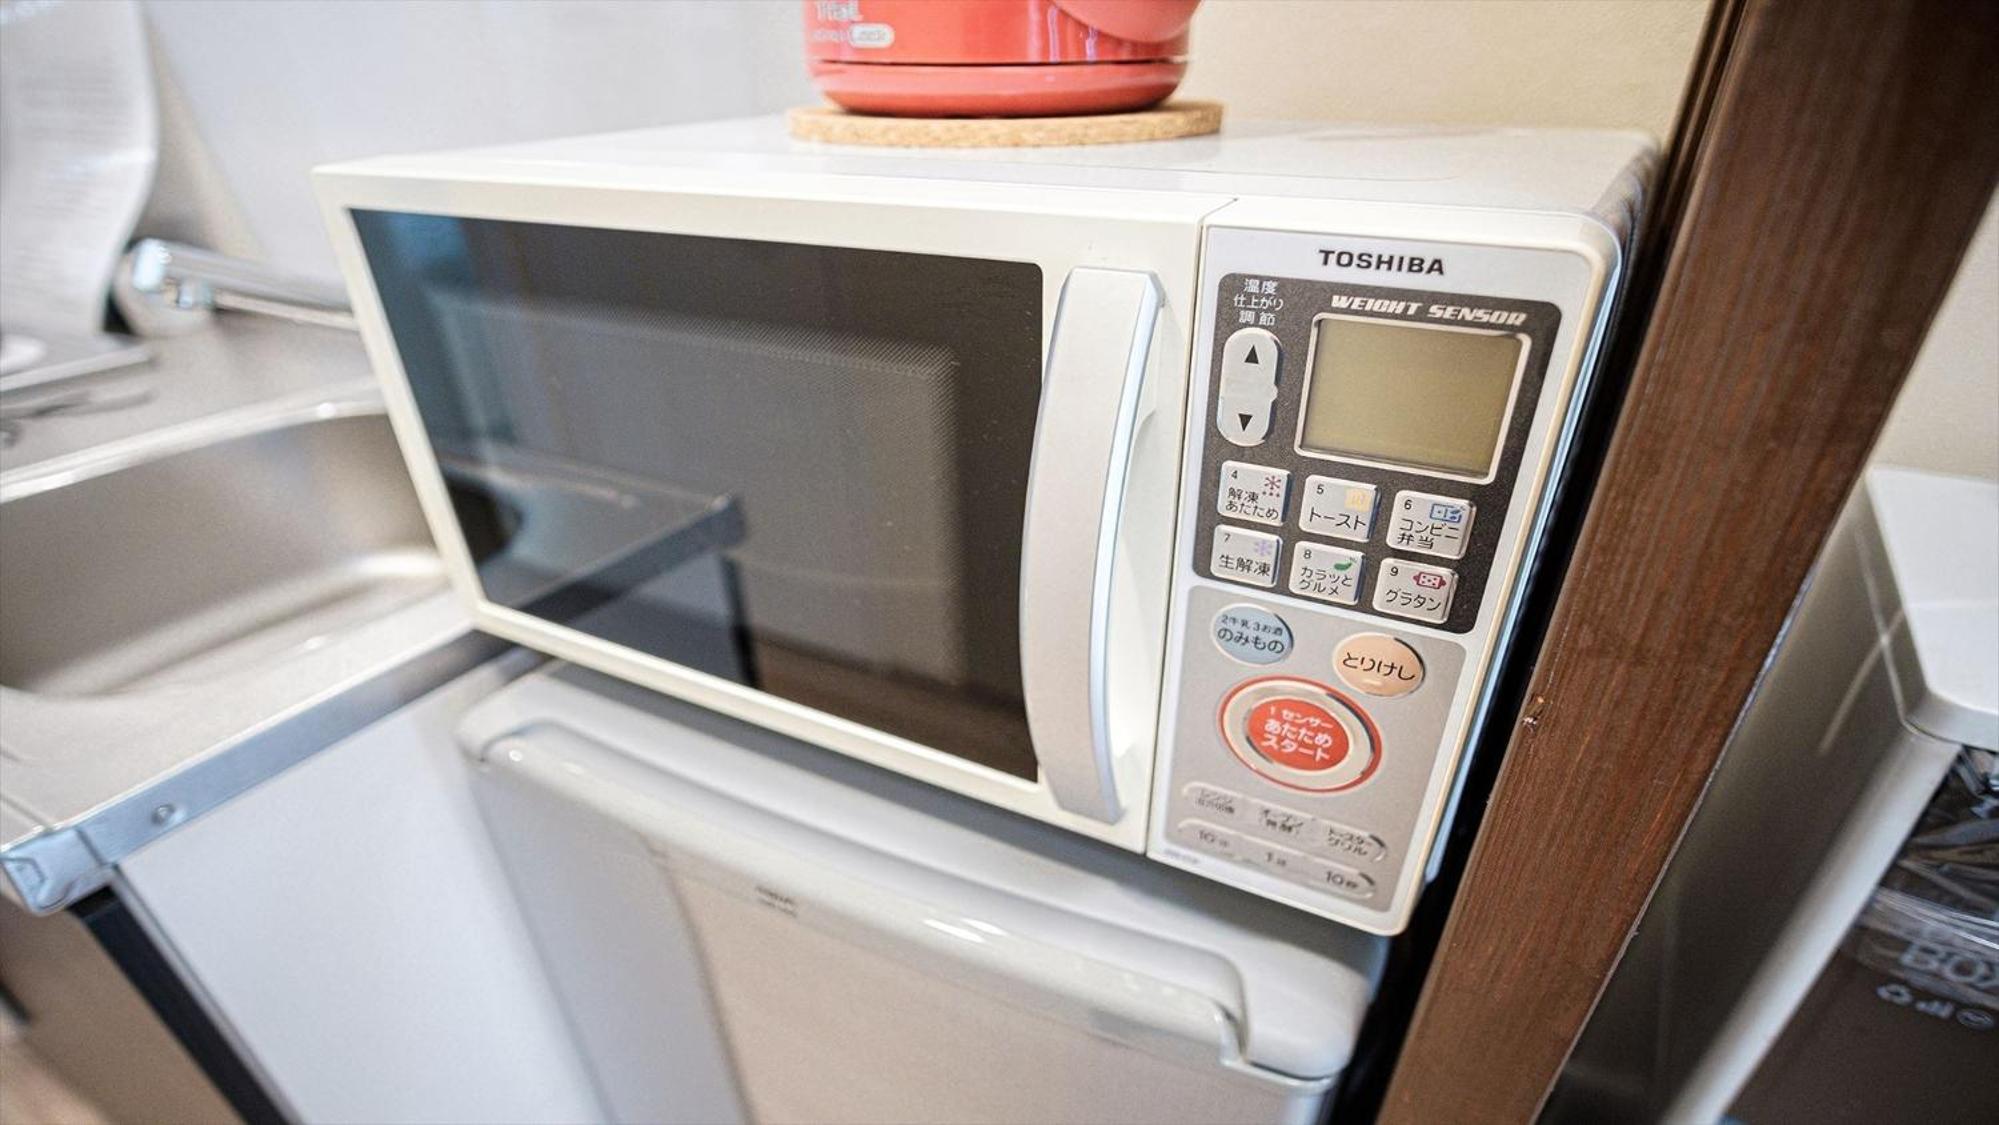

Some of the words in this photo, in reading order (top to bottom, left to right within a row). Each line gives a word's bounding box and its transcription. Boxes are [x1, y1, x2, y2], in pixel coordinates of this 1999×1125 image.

[1318, 249, 1446, 276] TOSHIBA
[1243, 279, 1279, 294] 温度
[1232, 294, 1285, 311] 仕上がり
[1330, 294, 1424, 317] WEIGHT
[1426, 304, 1528, 327] SENSOR
[1238, 310, 1276, 327] 調節
[1231, 469, 1238, 480] 4
[1227, 487, 1260, 504] 解凍
[1316, 484, 1325, 495] 5
[1225, 501, 1280, 521] あたため
[1404, 500, 1412, 510] 6
[1309, 507, 1367, 531] トースト
[1224, 533, 1231, 543] 7
[1399, 518, 1460, 540] コンビニ
[1397, 532, 1434, 550] 弁当
[1303, 549, 1312, 560] 8
[1218, 555, 1271, 577] 生解凍
[1390, 566, 1399, 577] 9
[1301, 566, 1353, 587] カラッと
[1299, 578, 1341, 596] グルメ
[1386, 588, 1441, 611] グラタン
[1217, 627, 1285, 654] のみもの
[1342, 651, 1416, 681] とりけし
[1263, 718, 1333, 748] あたため
[1261, 733, 1330, 762] スタート
